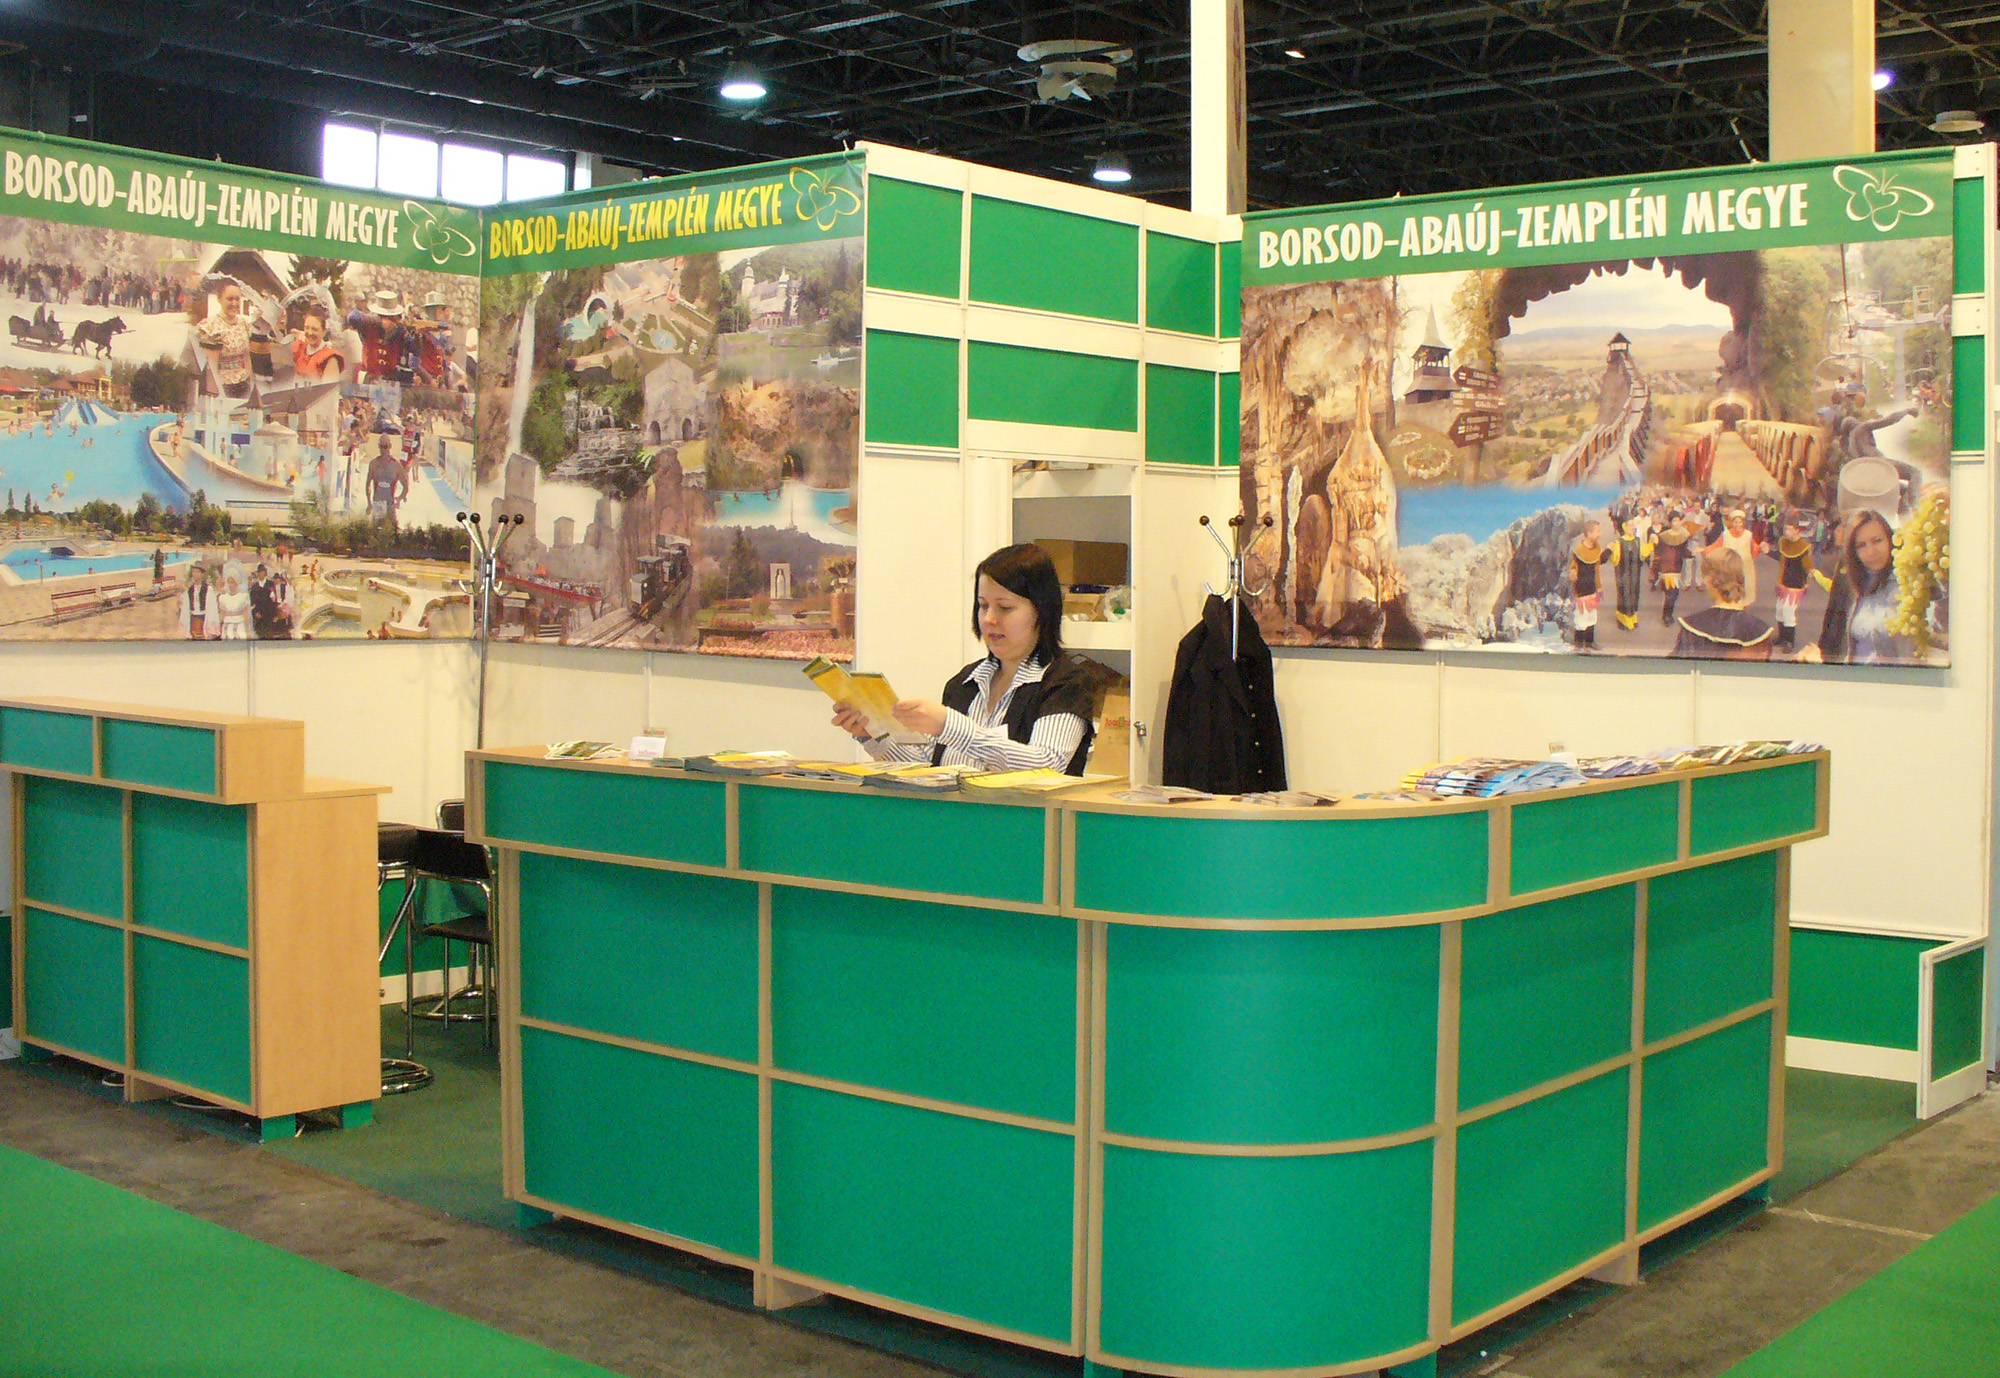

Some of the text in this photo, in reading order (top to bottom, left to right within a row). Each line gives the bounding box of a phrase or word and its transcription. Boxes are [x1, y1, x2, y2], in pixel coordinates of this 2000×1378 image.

[5, 150, 399, 249] BORSOD-ABAÚJ-ZEMPLÉN MEGYE
[489, 182, 784, 260] BORSOD-ABAÚJ-ZEMPLÉN MEGYE
[1258, 182, 1808, 269] BORSOD-ABAÚJ-ZEMPLÉN MEGYE
